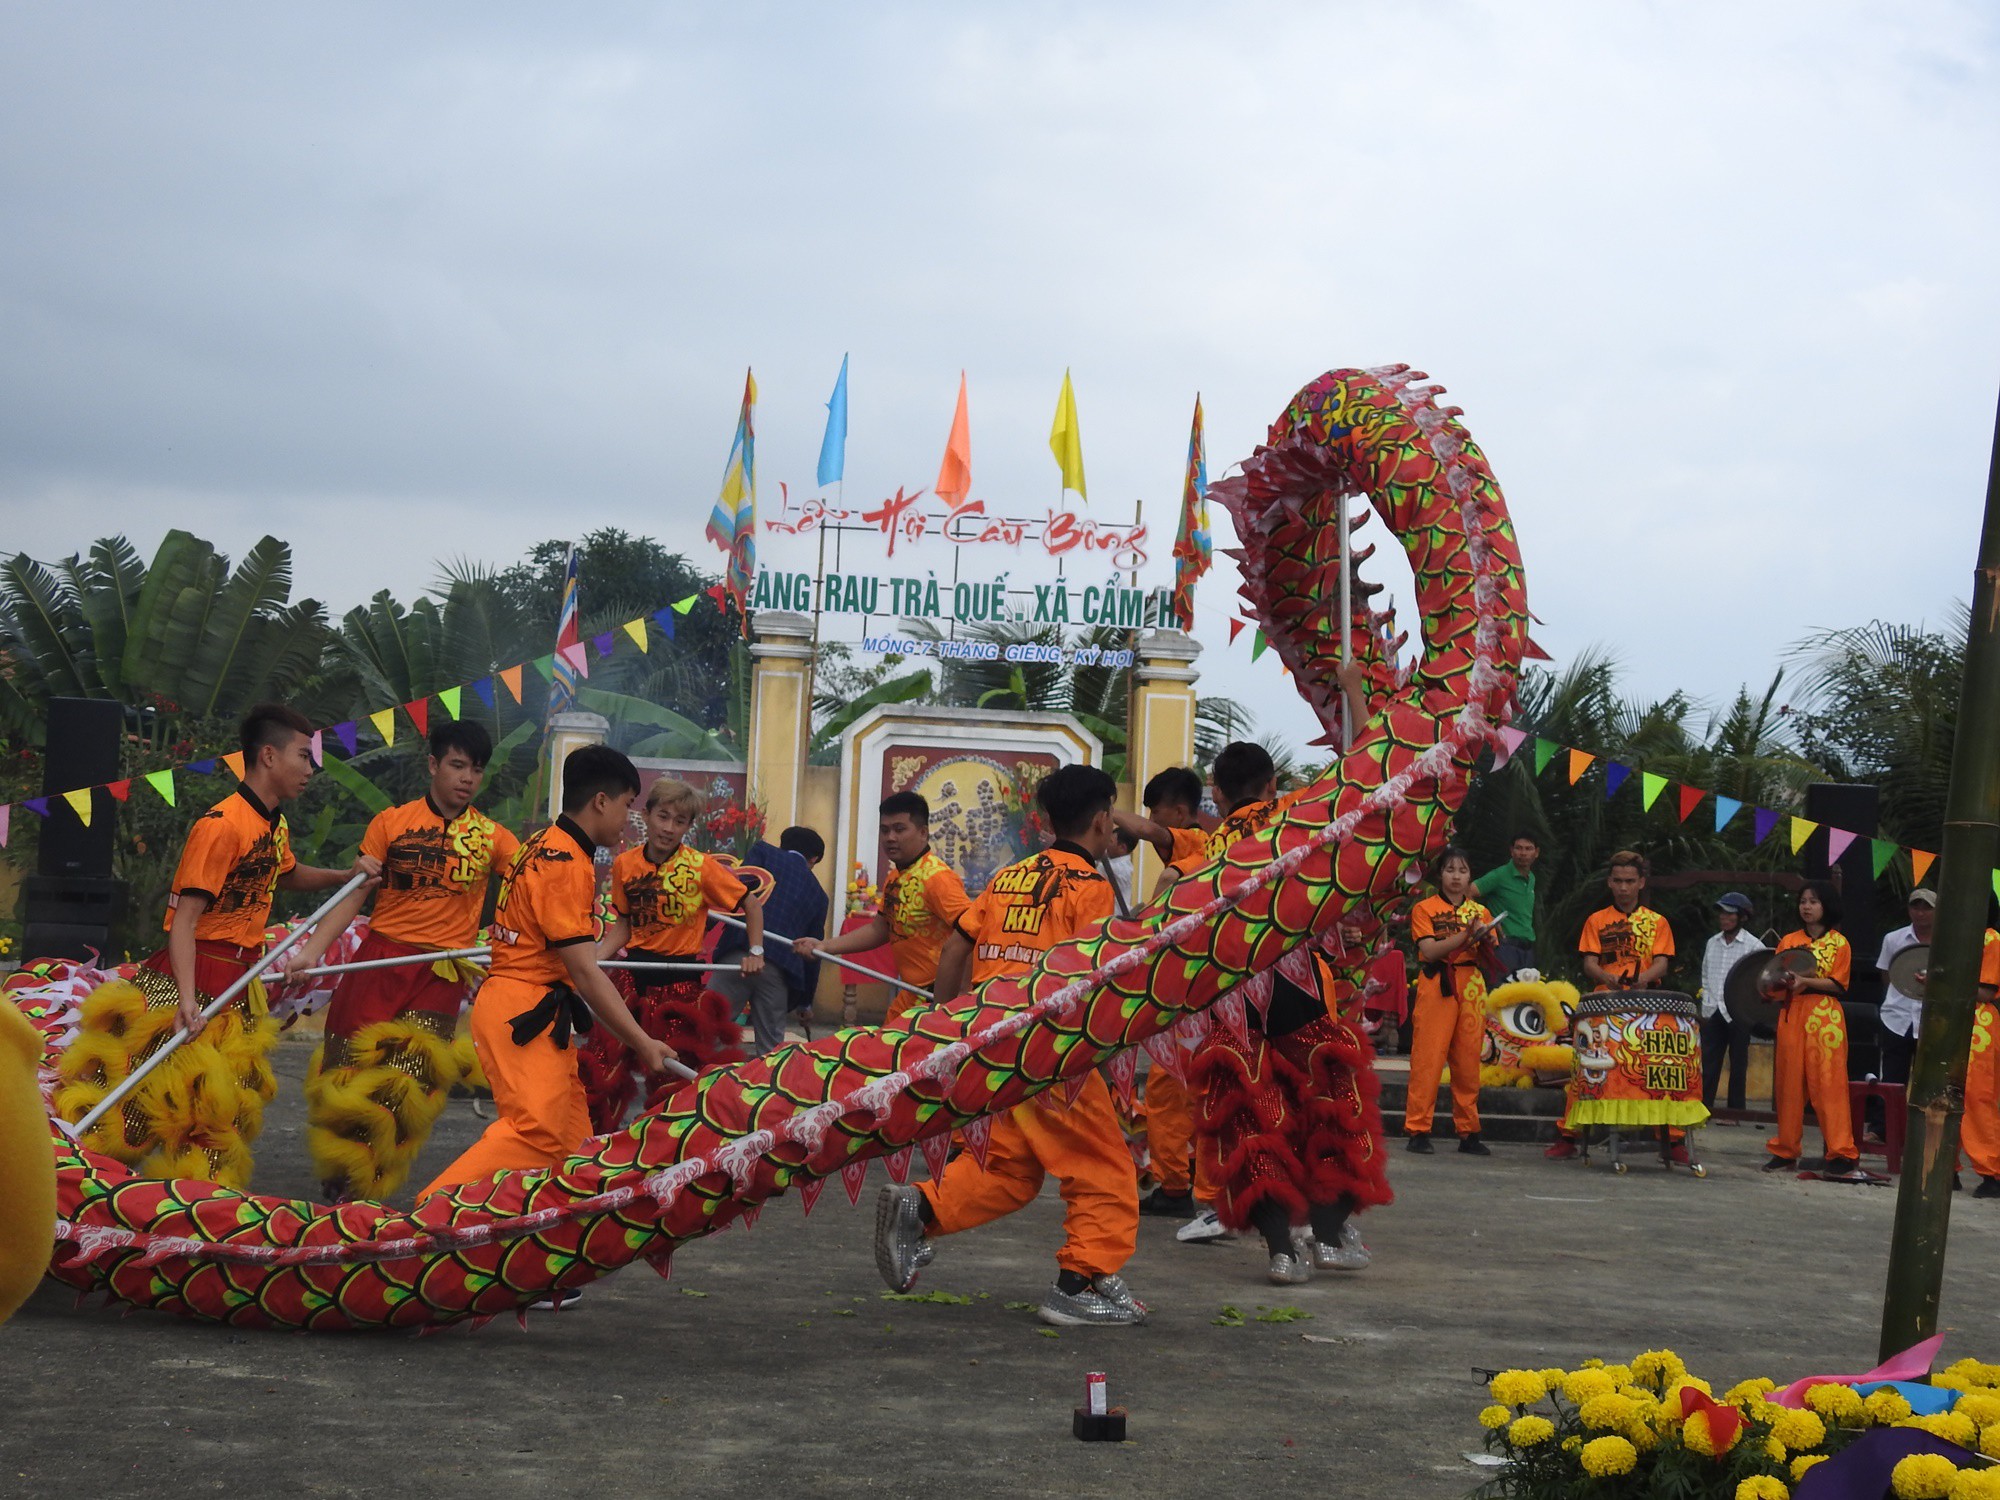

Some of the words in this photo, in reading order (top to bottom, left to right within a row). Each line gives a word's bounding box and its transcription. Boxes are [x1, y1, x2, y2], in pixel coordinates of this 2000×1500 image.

[1043, 508, 1147, 569] Bông
[824, 573, 879, 615] RAU
[890, 570, 941, 618] TRÀ
[953, 571, 1009, 624] QUẾ
[1033, 576, 1069, 624] XÃ
[1082, 571, 1144, 627] CẨM
[921, 642, 932, 655] 7
[993, 866, 1042, 894] HÀO
[1002, 903, 1047, 936] KHÍ
[1643, 1025, 1690, 1057] HÀO
[1646, 1061, 1688, 1092] KHÍ
